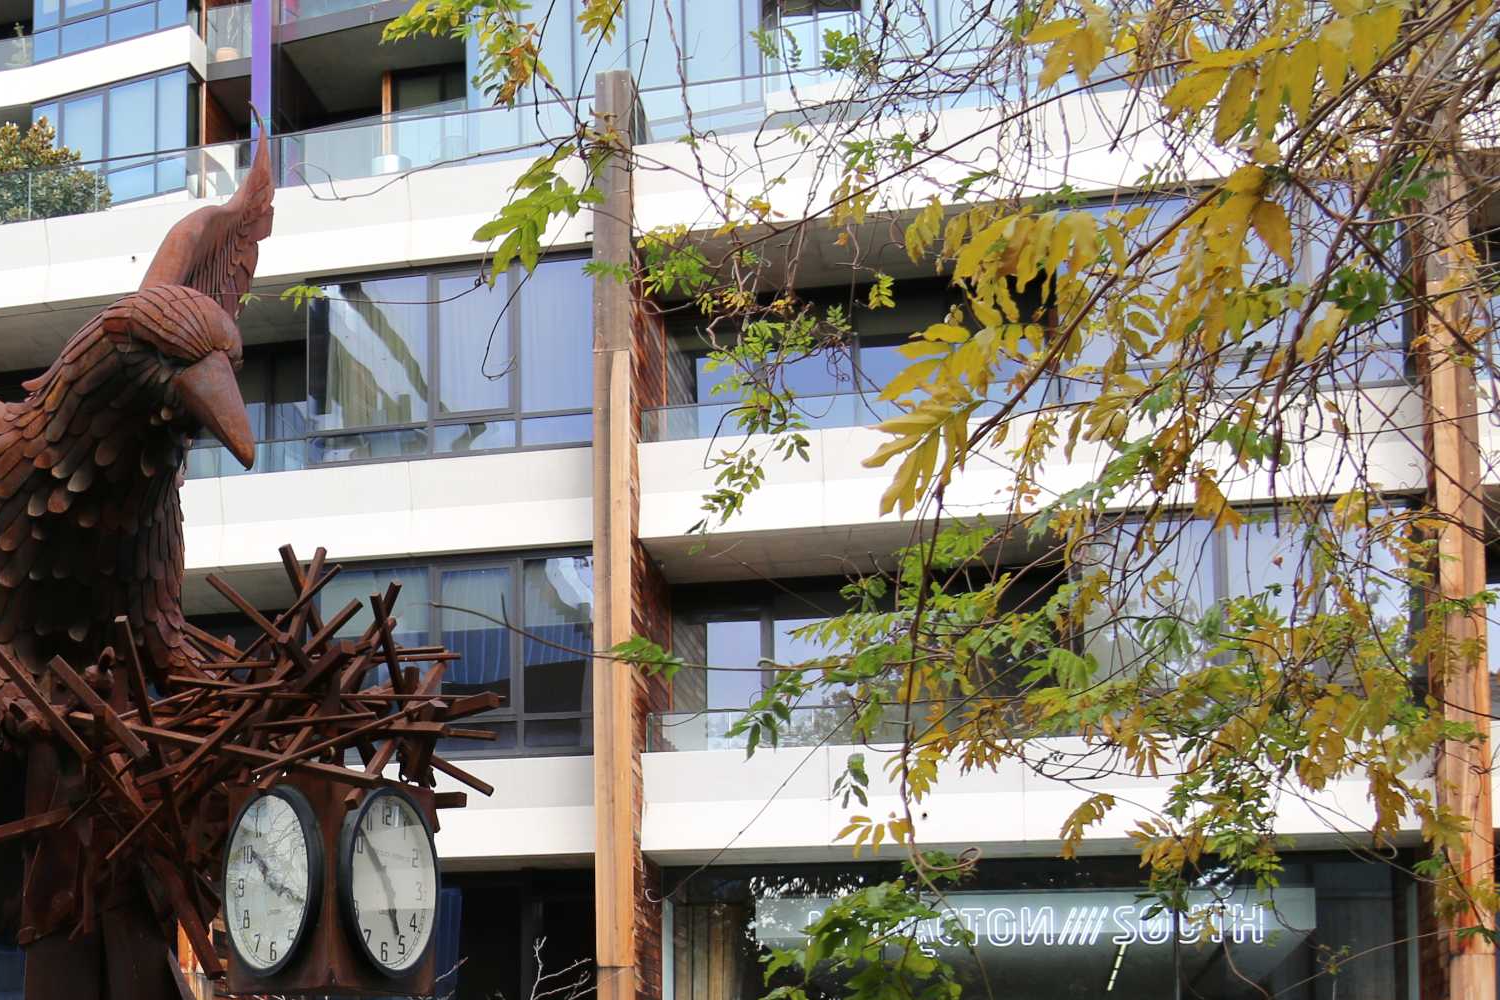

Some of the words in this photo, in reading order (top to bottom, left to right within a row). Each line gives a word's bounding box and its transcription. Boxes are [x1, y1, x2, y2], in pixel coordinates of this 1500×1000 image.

[243, 845, 253, 865] 10
[411, 847, 420, 868] 2
[243, 909, 251, 930] 8
[409, 911, 419, 933] 4
[269, 941, 278, 962] 6
[380, 941, 390, 962] 6
[397, 935, 406, 955] 5
